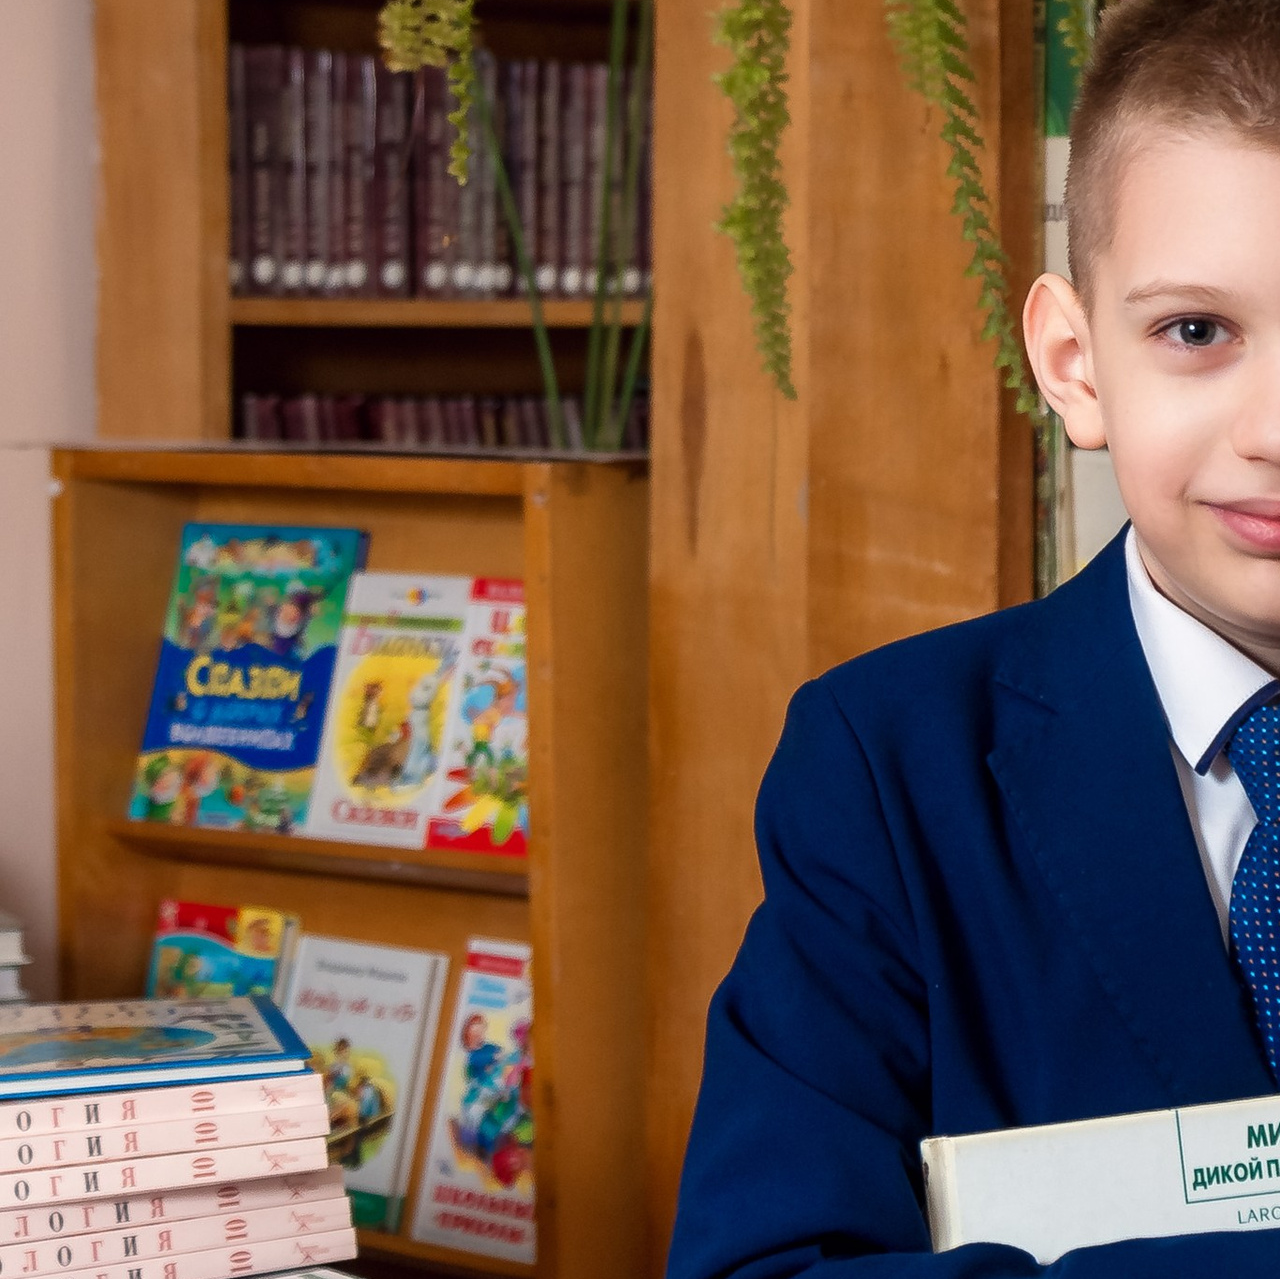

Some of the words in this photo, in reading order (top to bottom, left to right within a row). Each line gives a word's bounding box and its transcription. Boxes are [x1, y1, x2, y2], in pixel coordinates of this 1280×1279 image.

[191, 1091, 215, 1112] 10
[194, 1122, 218, 1143] 10
[192, 1157, 216, 1178] 10
[1192, 1156, 1264, 1190] ДИКОЙ
[217, 1186, 240, 1208] 10
[224, 1218, 248, 1240] 10
[229, 1251, 253, 1272] 10
